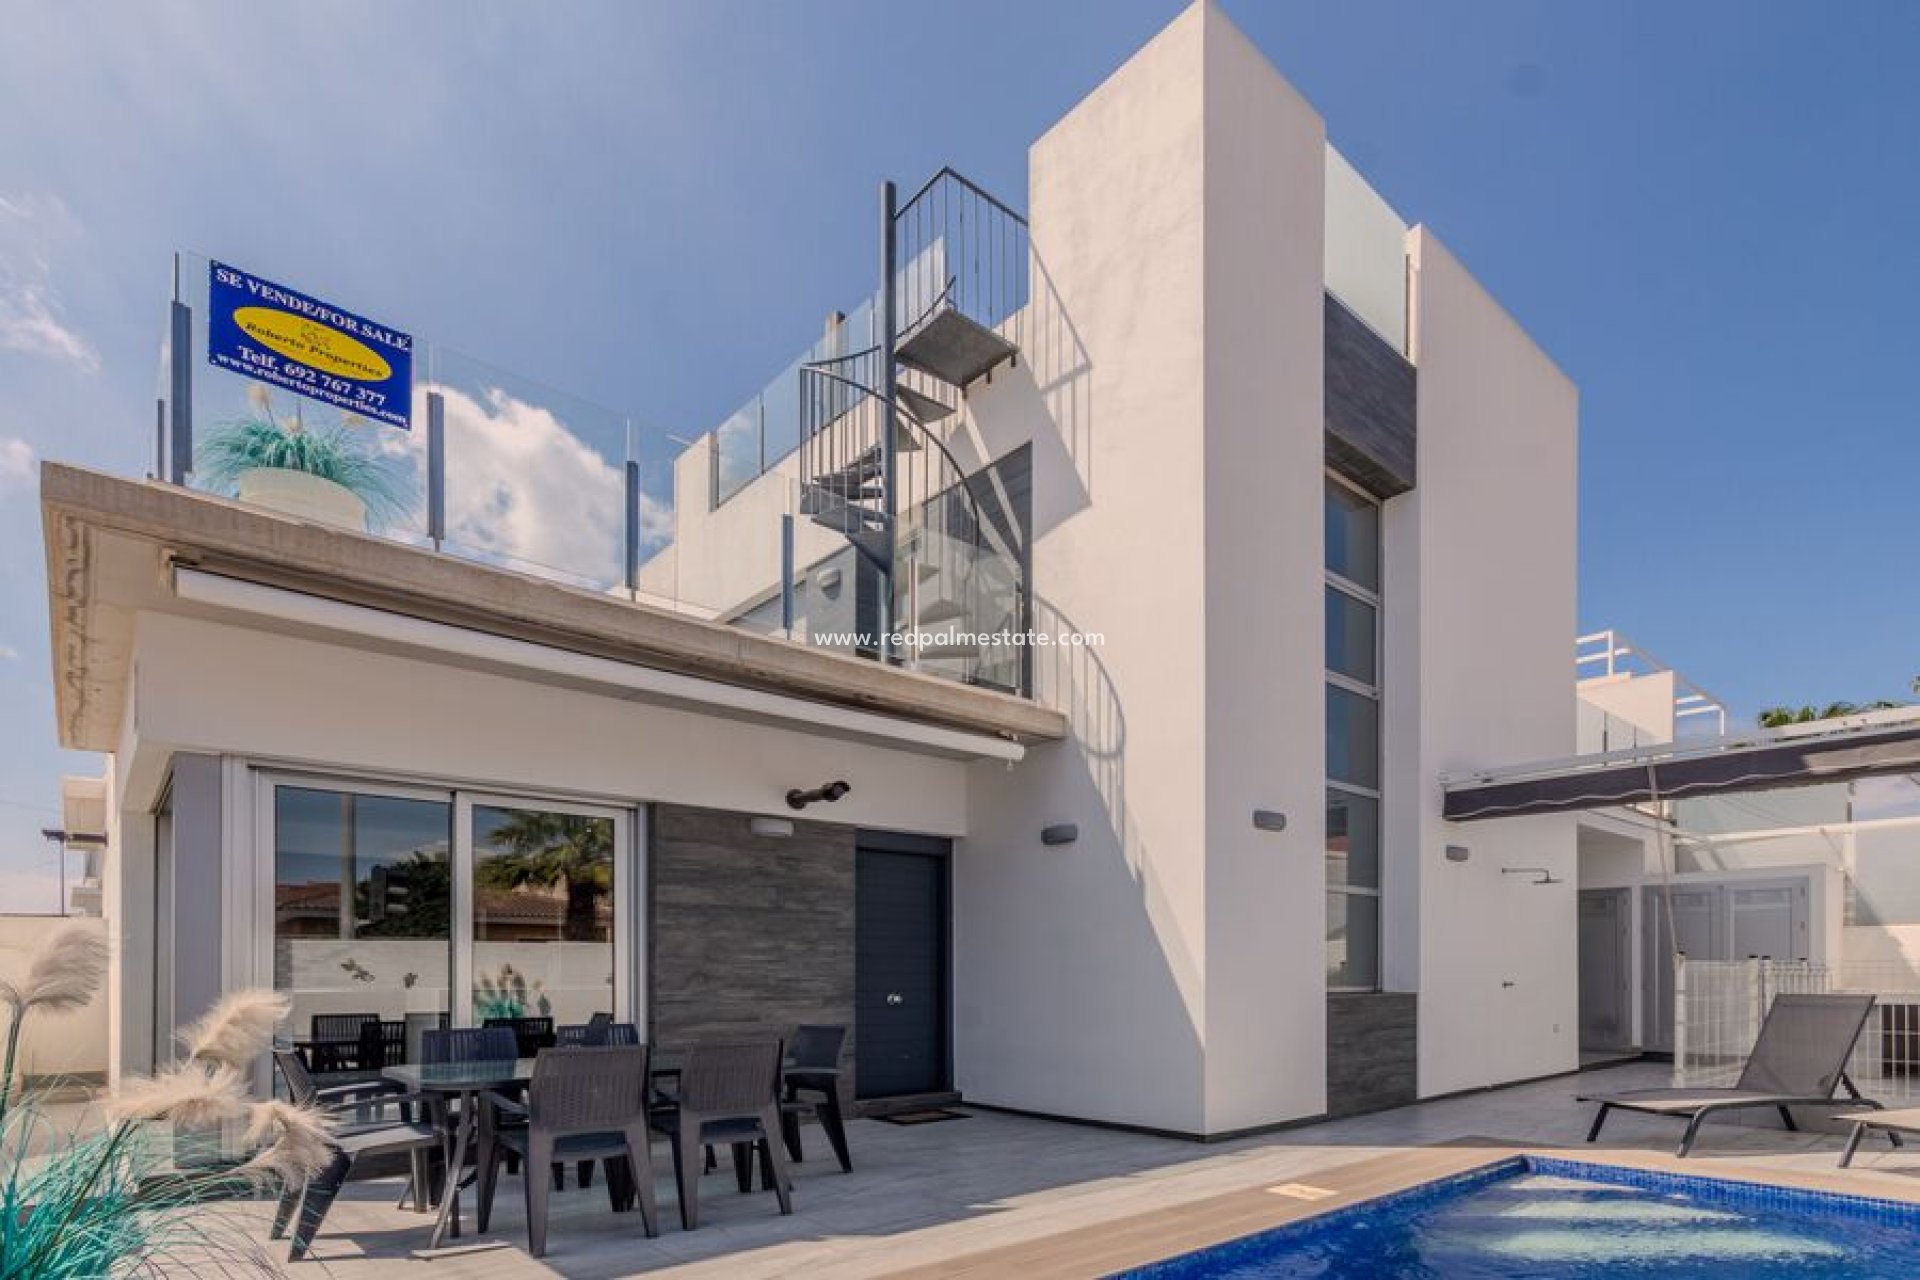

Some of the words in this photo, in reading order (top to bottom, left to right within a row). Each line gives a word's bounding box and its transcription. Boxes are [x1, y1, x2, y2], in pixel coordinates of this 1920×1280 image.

[216, 268, 243, 289] SE
[247, 278, 358, 332] VENDE/FOR
[360, 324, 411, 351] SALE
[237, 345, 280, 370] Telf.
[285, 363, 317, 383] 692
[321, 374, 352, 394] 767
[356, 388, 386, 406] 377
[245, 322, 305, 351] Roberto
[309, 344, 384, 377] Properties
[216, 353, 407, 423] www.robertoproperties.com
